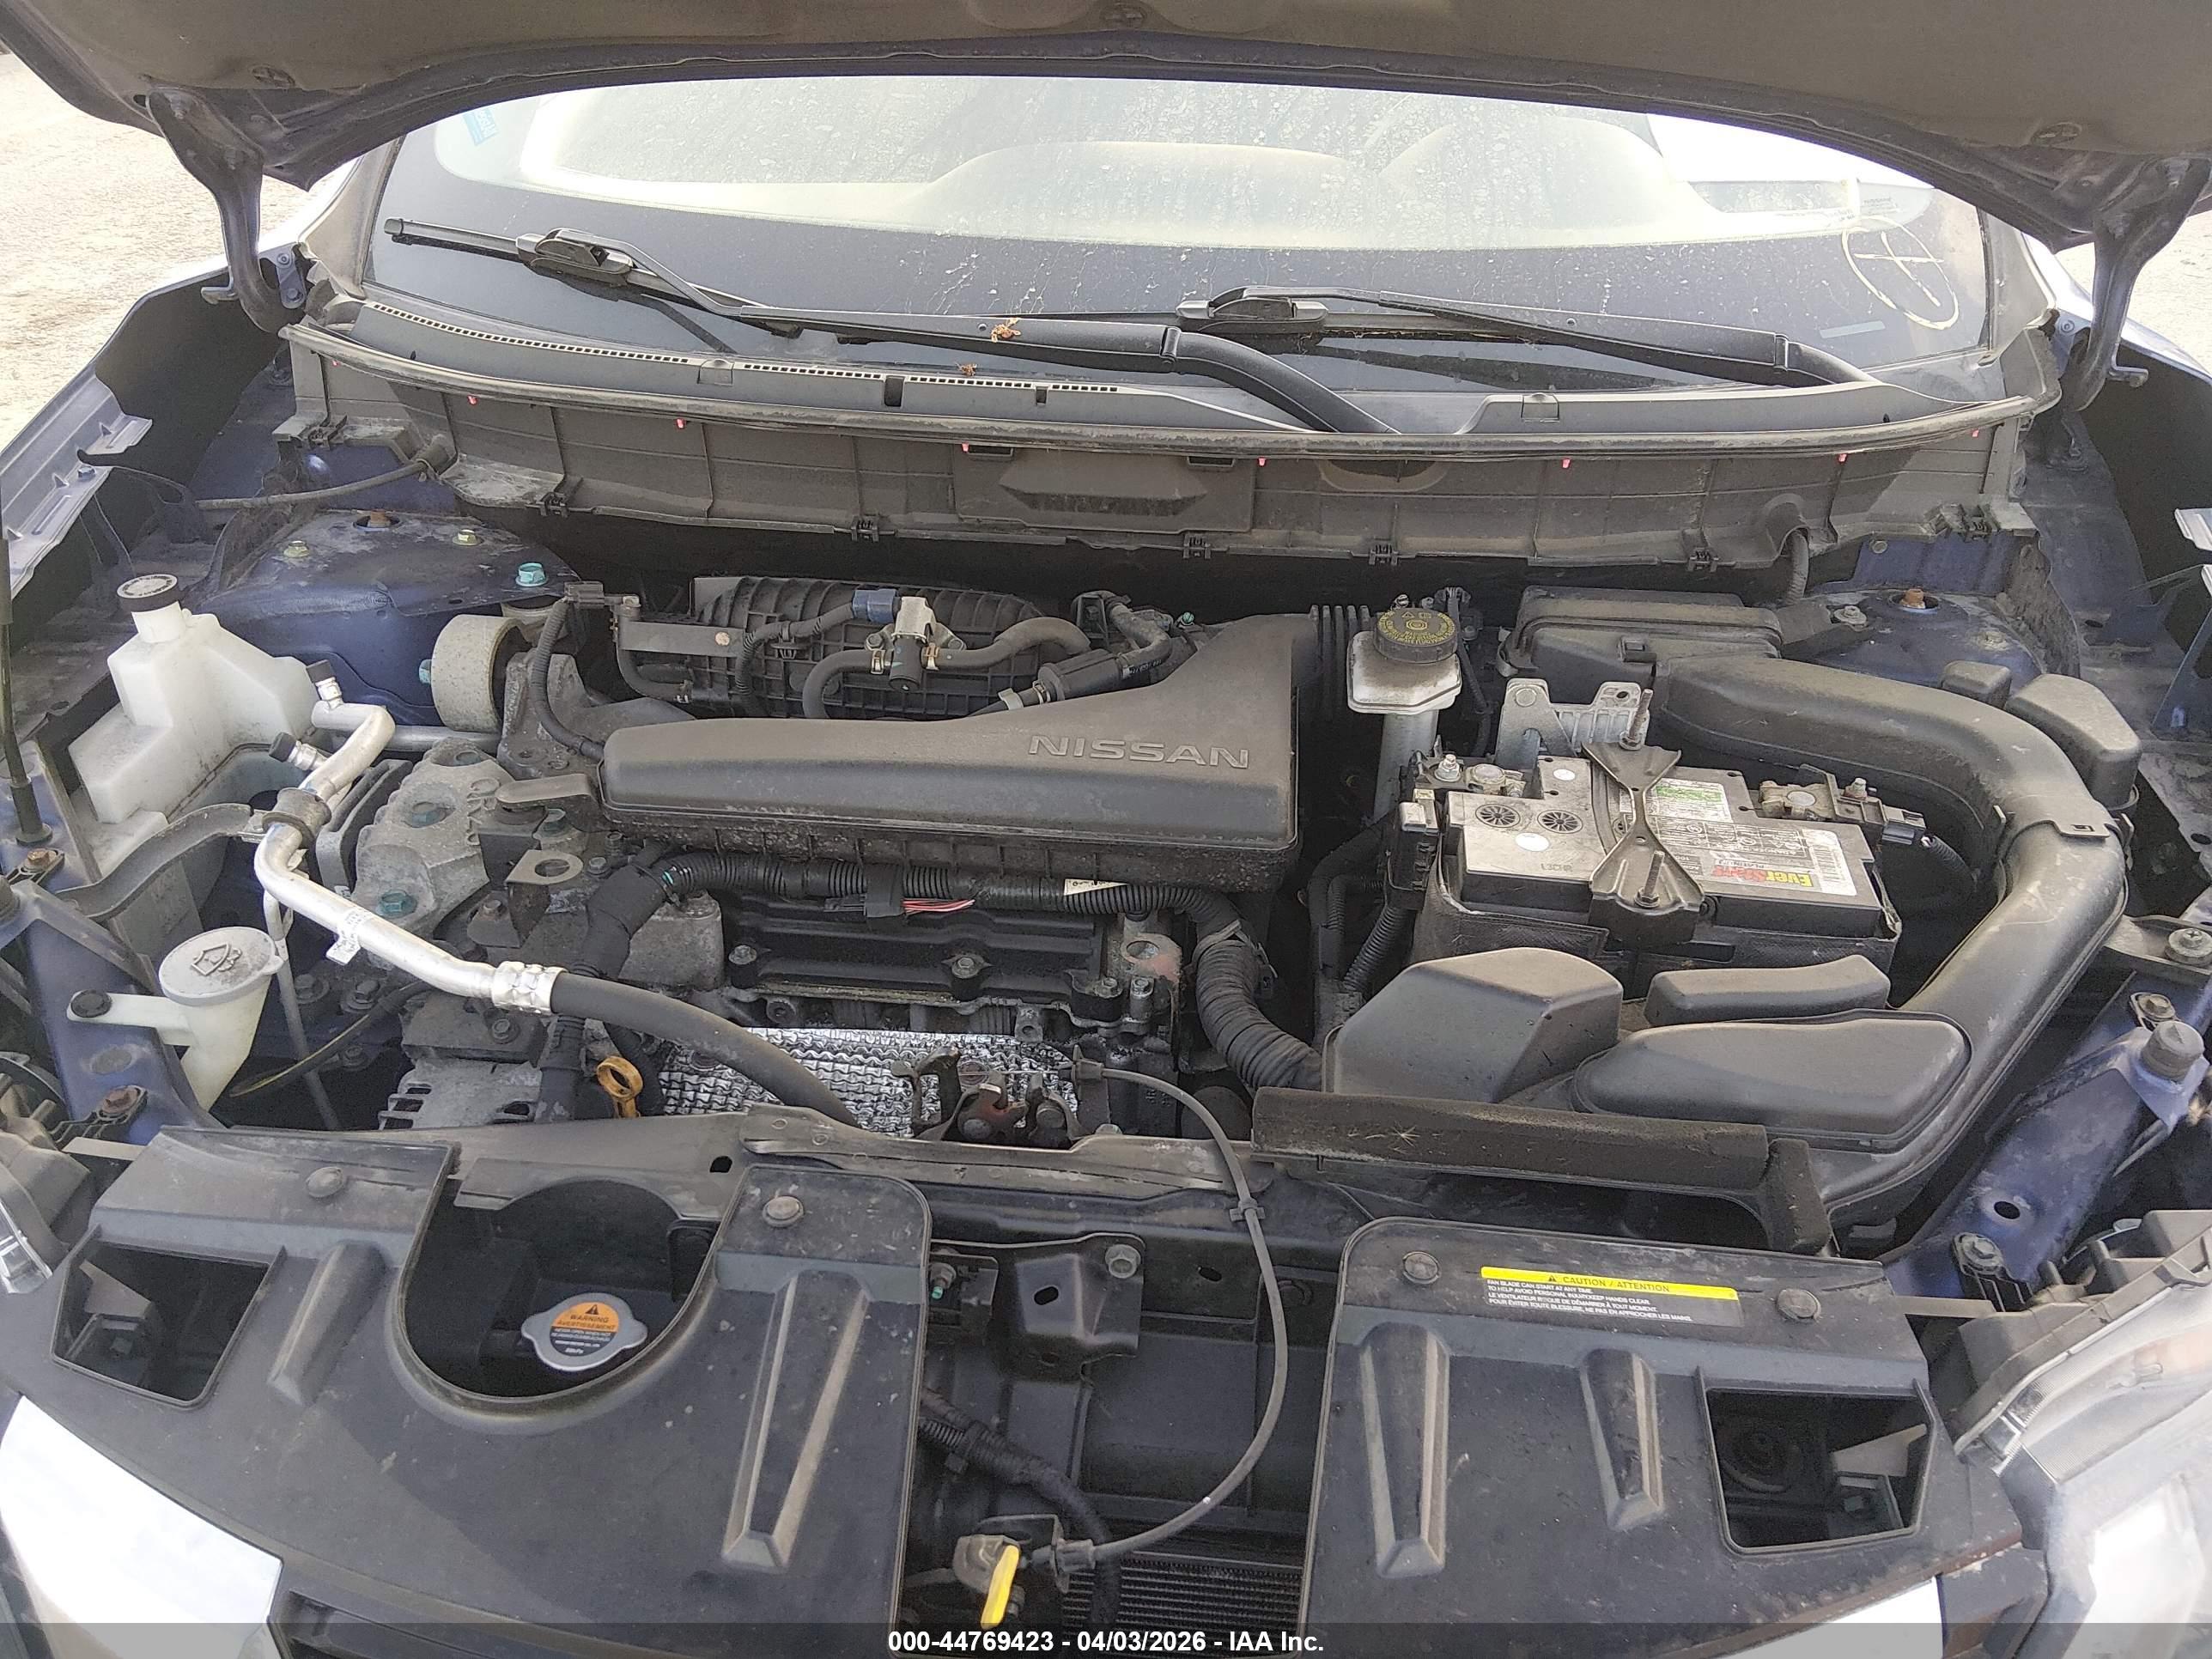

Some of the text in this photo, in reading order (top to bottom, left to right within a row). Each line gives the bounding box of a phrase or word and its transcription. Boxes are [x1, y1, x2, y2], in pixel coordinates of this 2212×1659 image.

[1029, 735, 1249, 769] NISSAN
[1711, 865, 1814, 888] EverStart
[1563, 1276, 1606, 1287] CAUTION
[1617, 1280, 1670, 1292] ATTENTION
[1497, 1292, 1537, 1302] VENTILATEUR
[1534, 1289, 1567, 1297] PERSONAL
[1605, 1295, 1628, 1304] HANDS
[570, 1315, 609, 1323] WARNING
[1619, 1310, 1657, 1319] APPROCHER
[557, 1319, 616, 1330] AVERTISSEMENT
